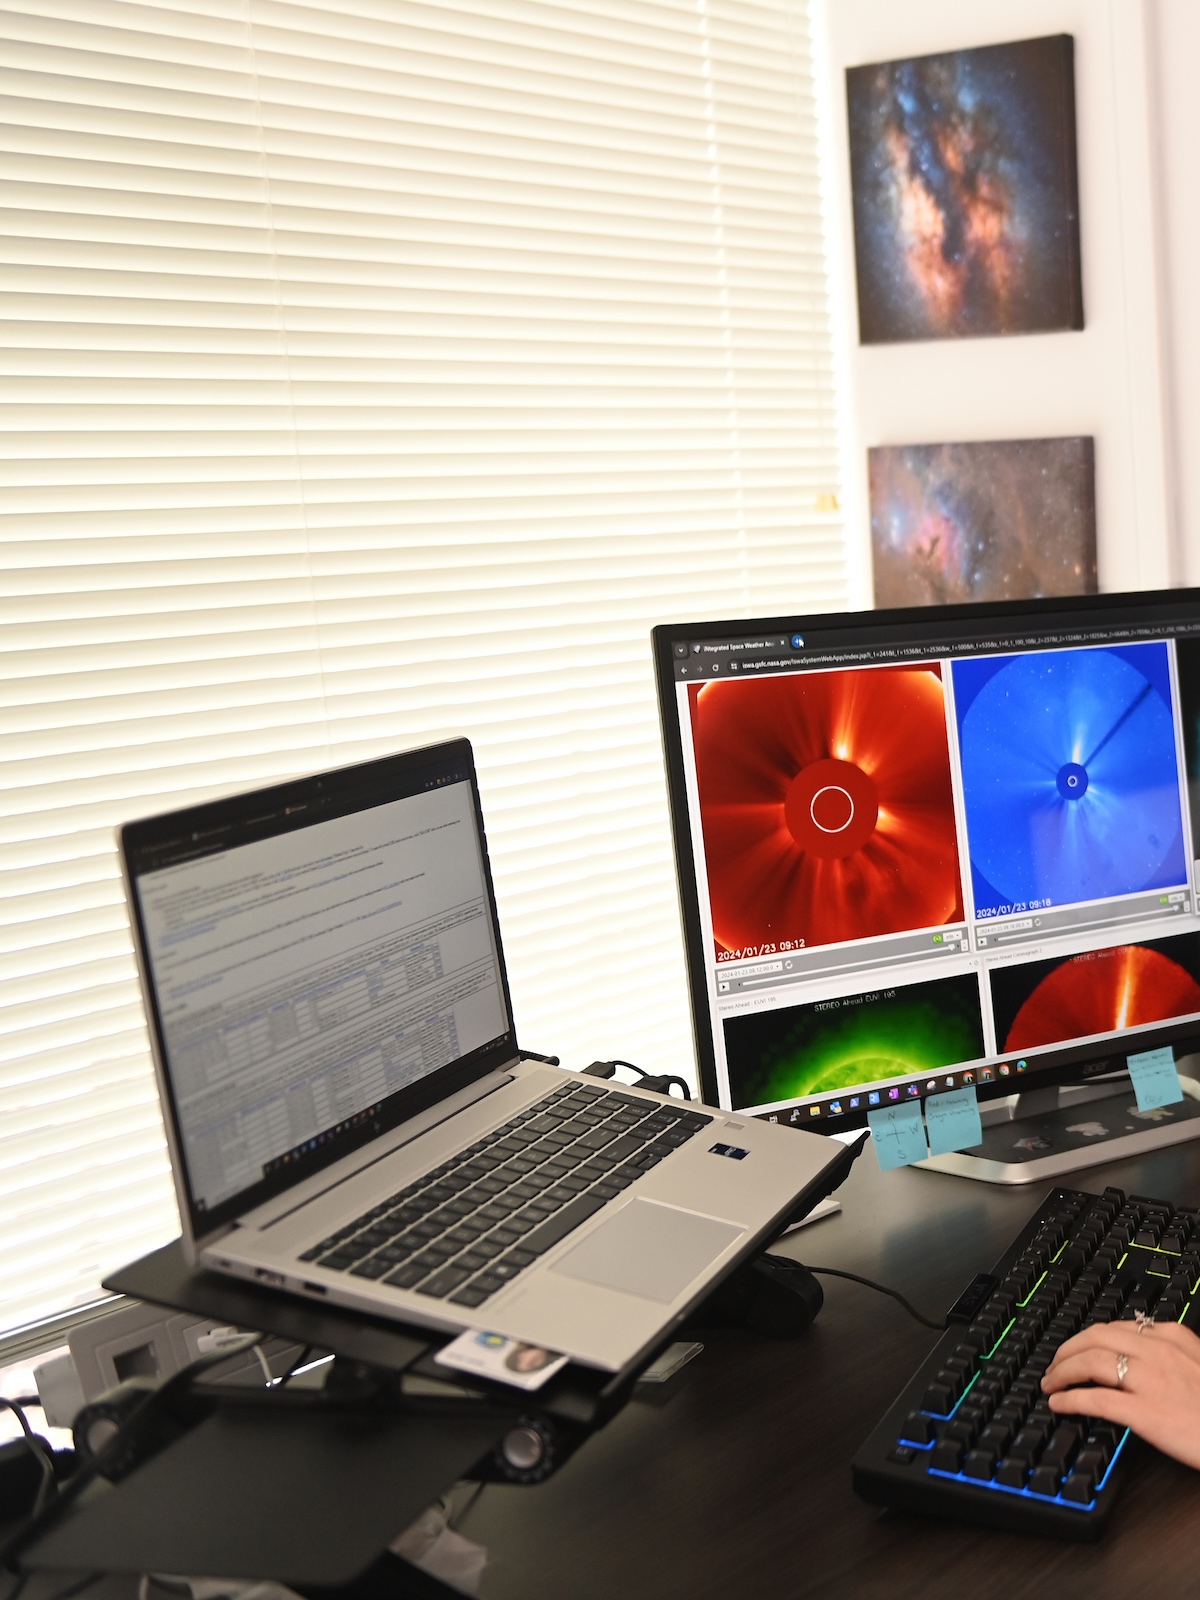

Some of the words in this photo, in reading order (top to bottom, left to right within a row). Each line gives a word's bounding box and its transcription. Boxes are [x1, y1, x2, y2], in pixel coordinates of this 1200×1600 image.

[730, 642, 744, 652] Space
[745, 641, 764, 649] Weather
[977, 902, 1027, 919] 2024/01/23
[1029, 898, 1052, 910] 09:18
[717, 943, 777, 961] 2024/01/23
[779, 938, 806, 951] 09:12
[814, 1000, 841, 1012] STEREO
[888, 1111, 896, 1120] N
[908, 1123, 918, 1135] W
